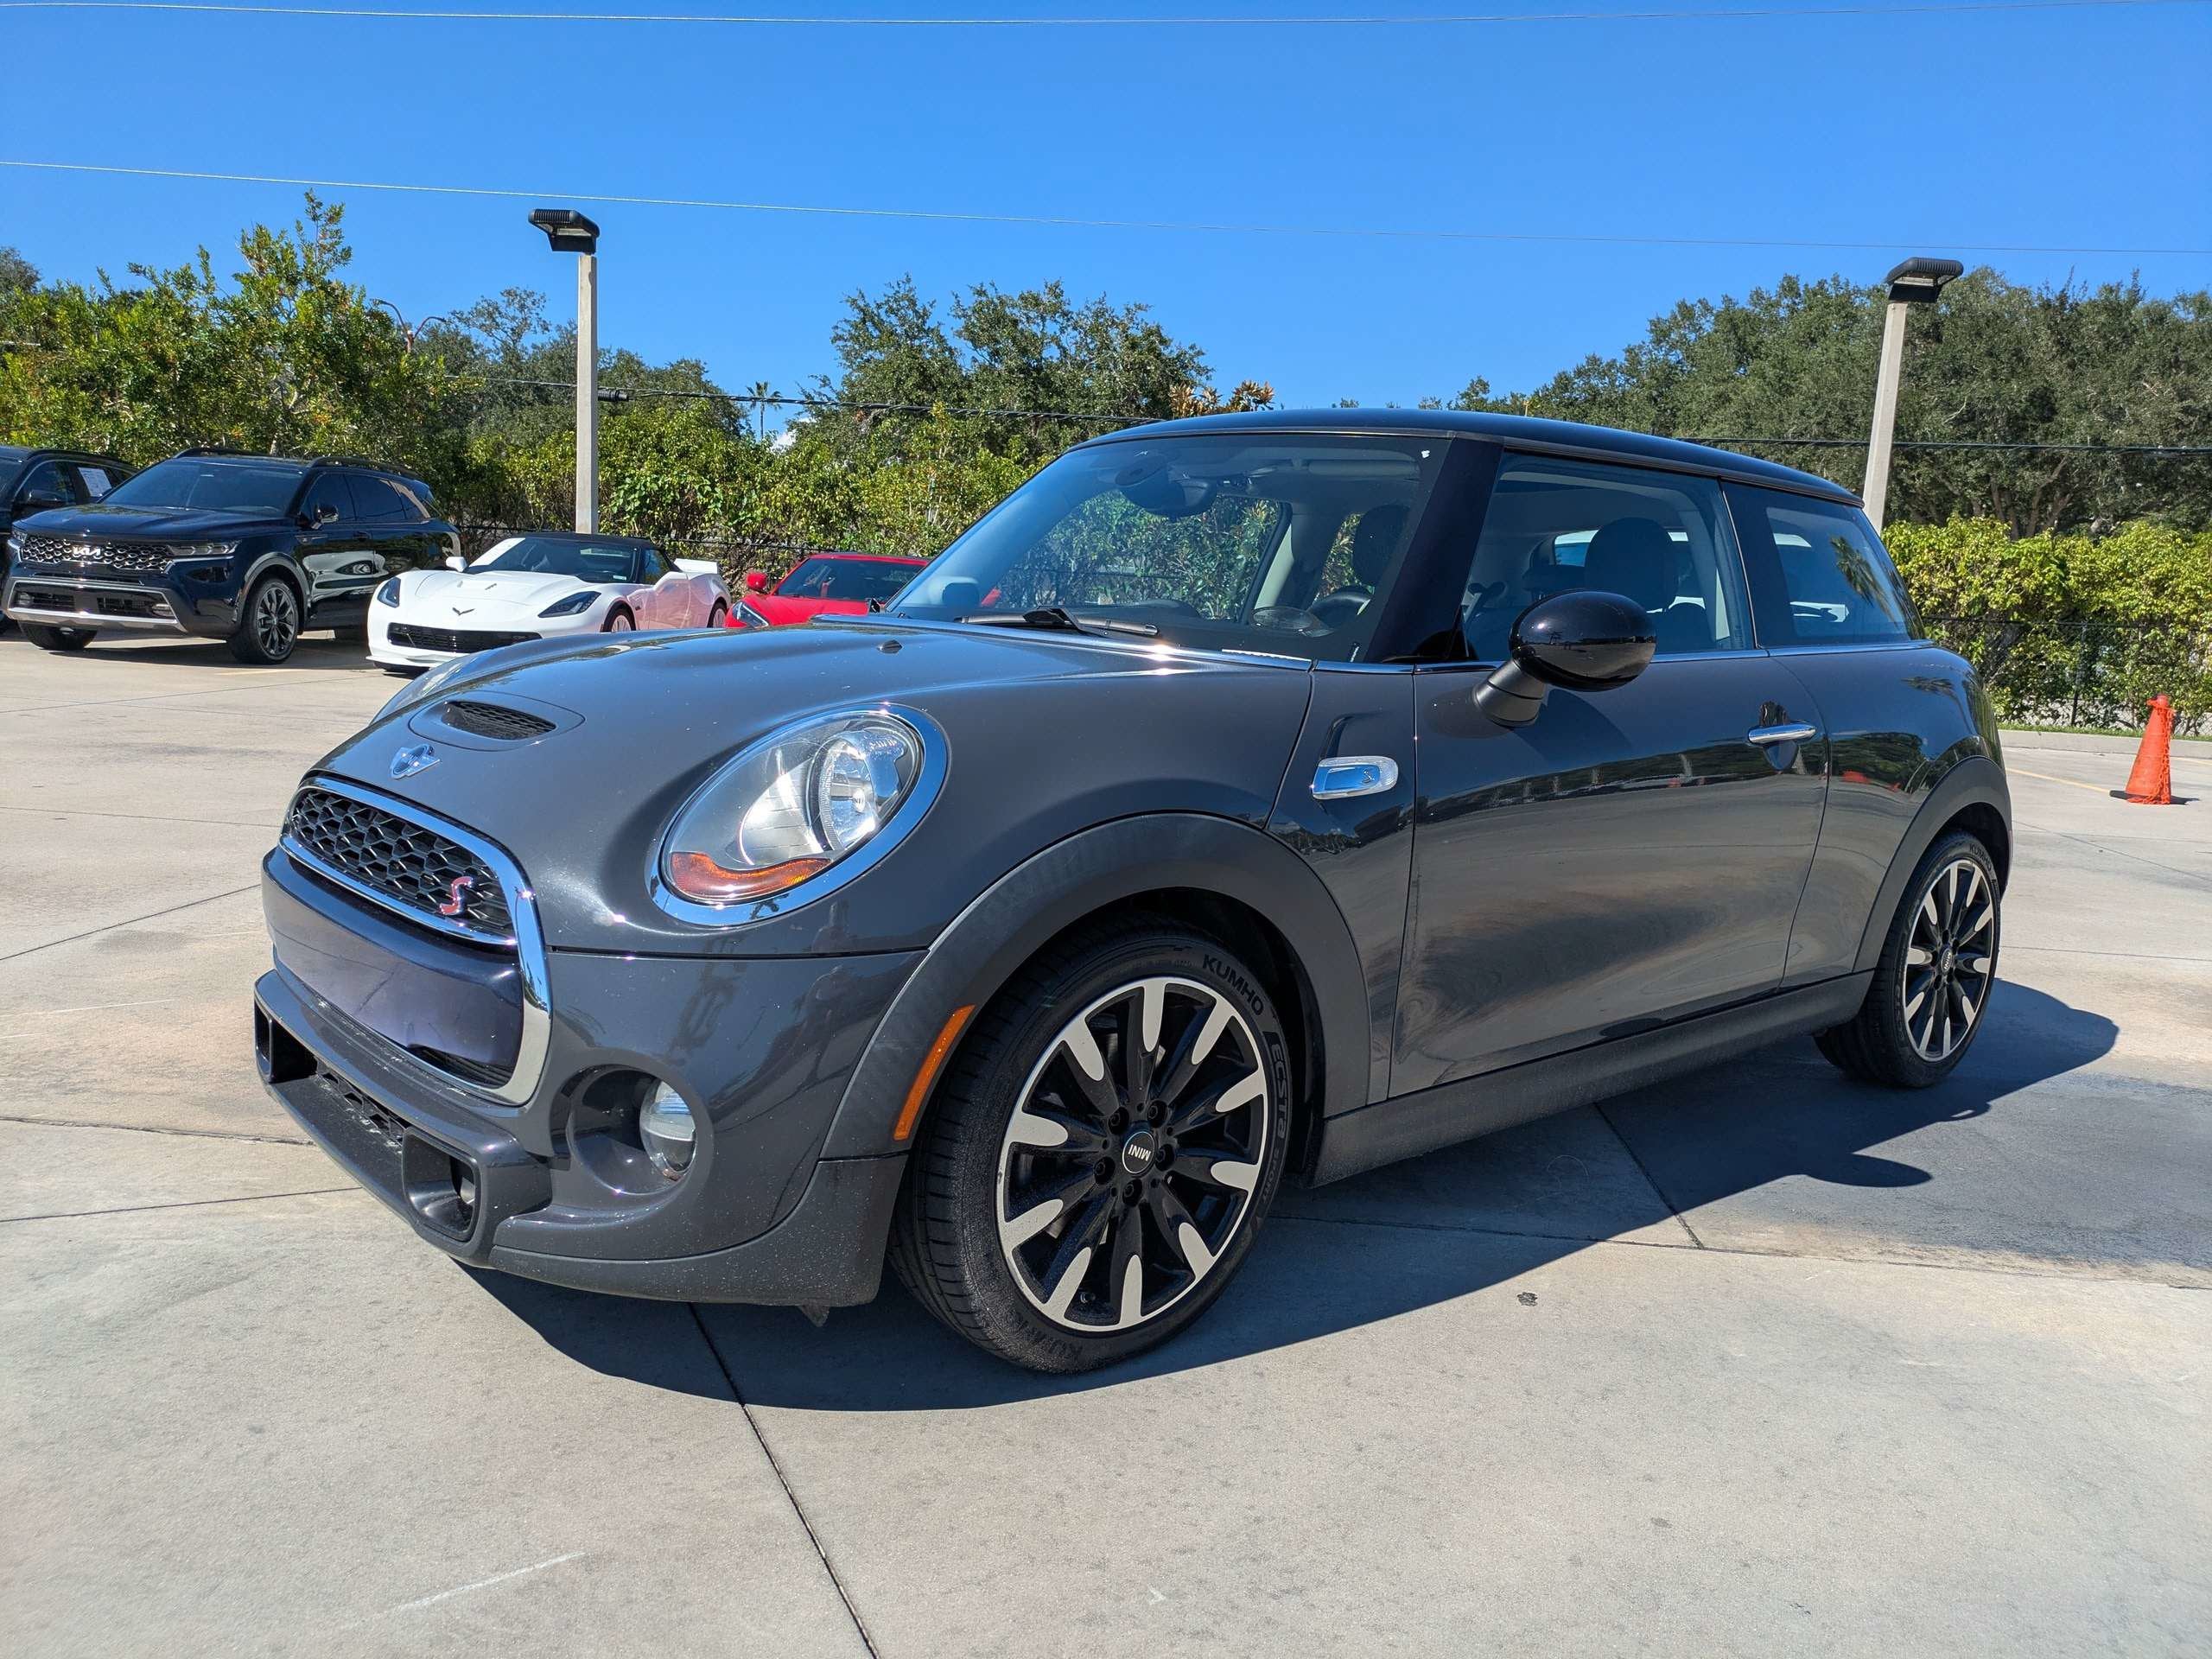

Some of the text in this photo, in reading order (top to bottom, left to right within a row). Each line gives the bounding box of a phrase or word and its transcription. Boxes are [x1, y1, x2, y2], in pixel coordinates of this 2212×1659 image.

[439, 875, 475, 916] S
[1202, 953, 1264, 1016] KUMHO
[1128, 1144, 1152, 1162] MINI
